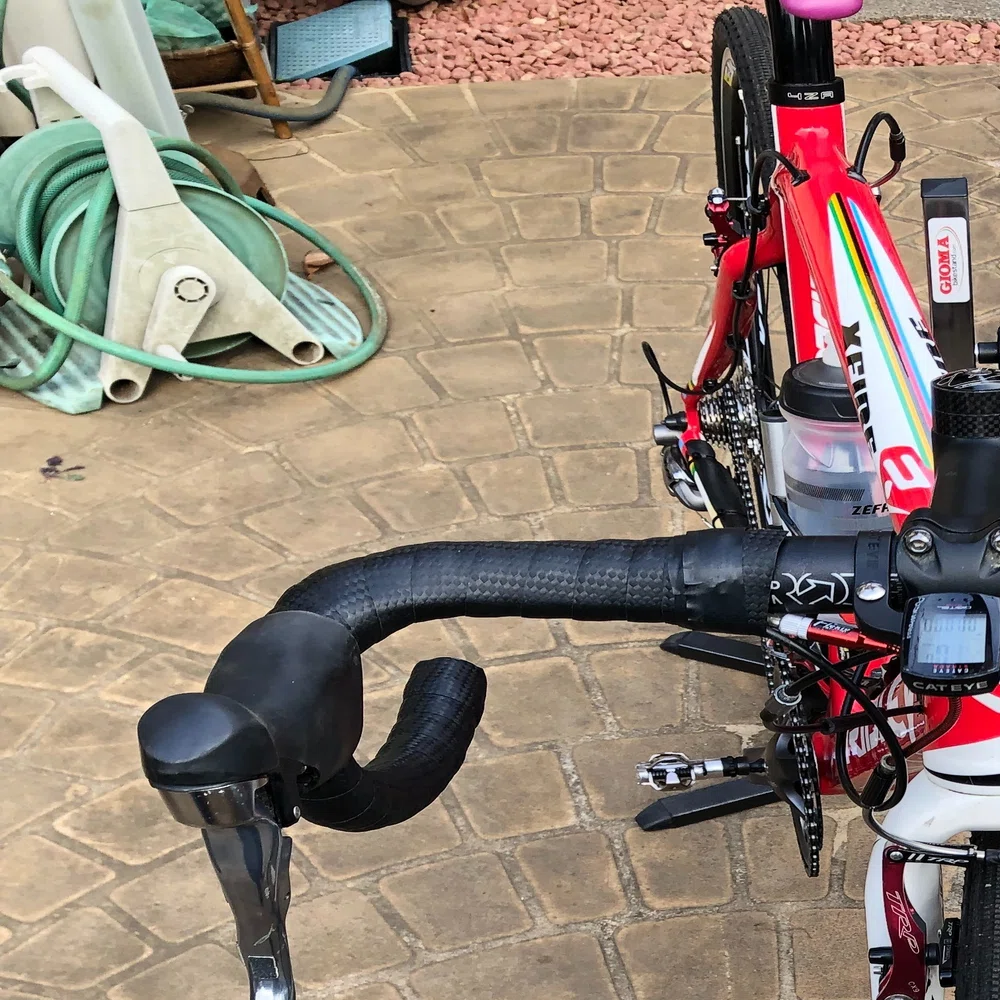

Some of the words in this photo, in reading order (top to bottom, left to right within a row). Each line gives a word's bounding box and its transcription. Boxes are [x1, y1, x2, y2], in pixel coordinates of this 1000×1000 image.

[937, 236, 952, 295] GIOMA
[913, 681, 988, 692] CATEYE
[927, 856, 969, 864] TRP
[886, 890, 920, 955] TRP
